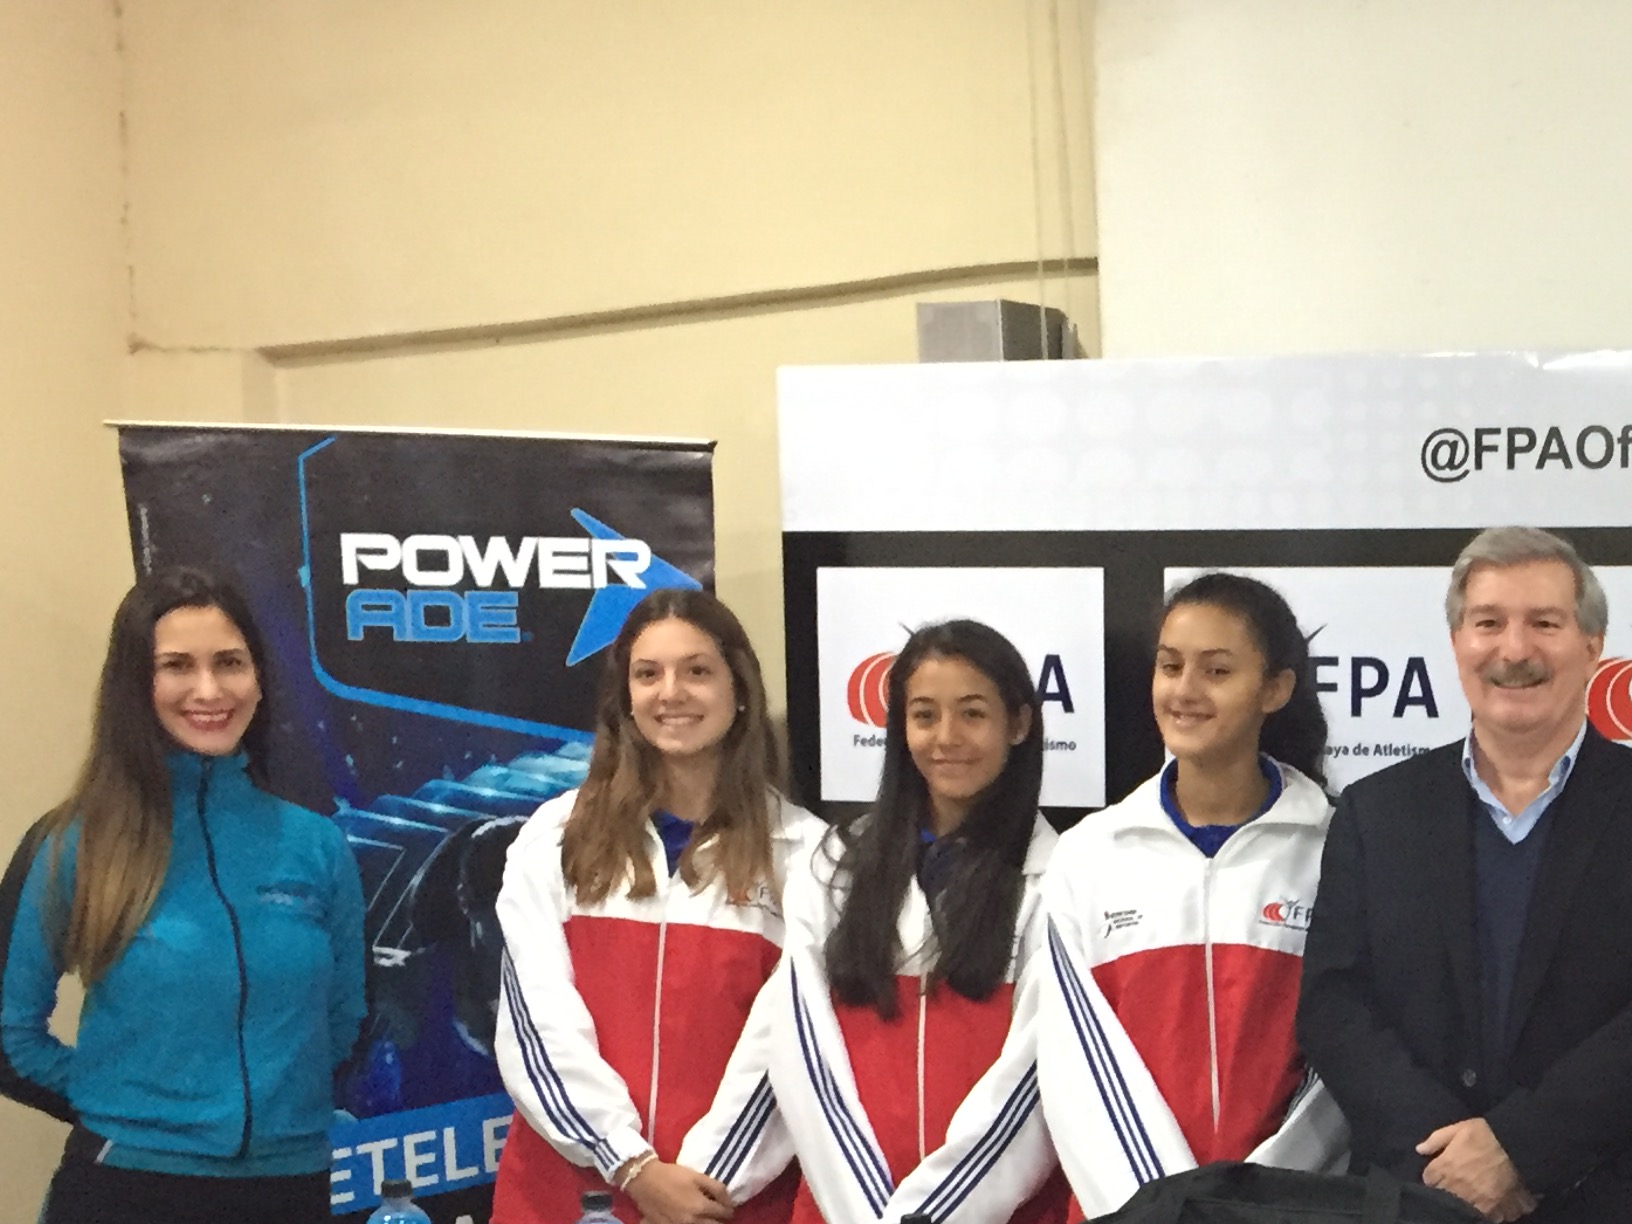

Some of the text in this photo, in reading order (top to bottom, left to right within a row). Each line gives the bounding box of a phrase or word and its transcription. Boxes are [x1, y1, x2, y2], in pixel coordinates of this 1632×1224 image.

[340, 533, 652, 589] POWER
[1352, 743, 1370, 757] de
[330, 1114, 514, 1205] ETELE
